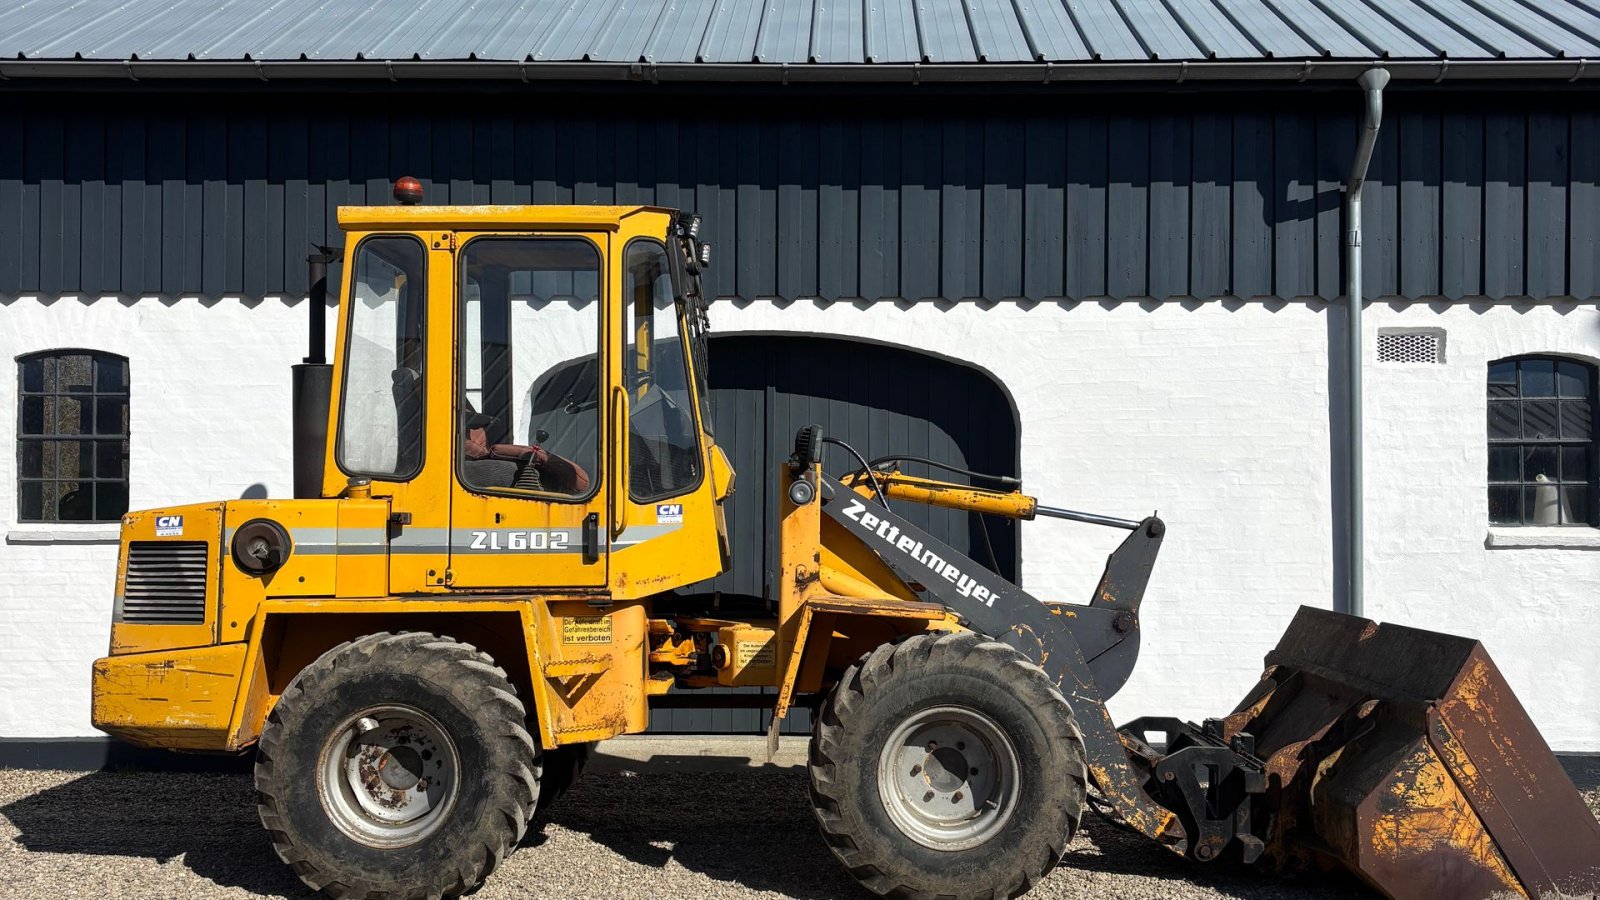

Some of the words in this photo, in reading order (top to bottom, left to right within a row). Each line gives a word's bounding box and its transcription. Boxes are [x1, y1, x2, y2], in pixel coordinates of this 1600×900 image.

[658, 504, 680, 515] CN
[158, 516, 181, 527] CN
[470, 531, 502, 550] ZL
[508, 531, 569, 550] 602
[842, 498, 1001, 608] Zettelmeyer
